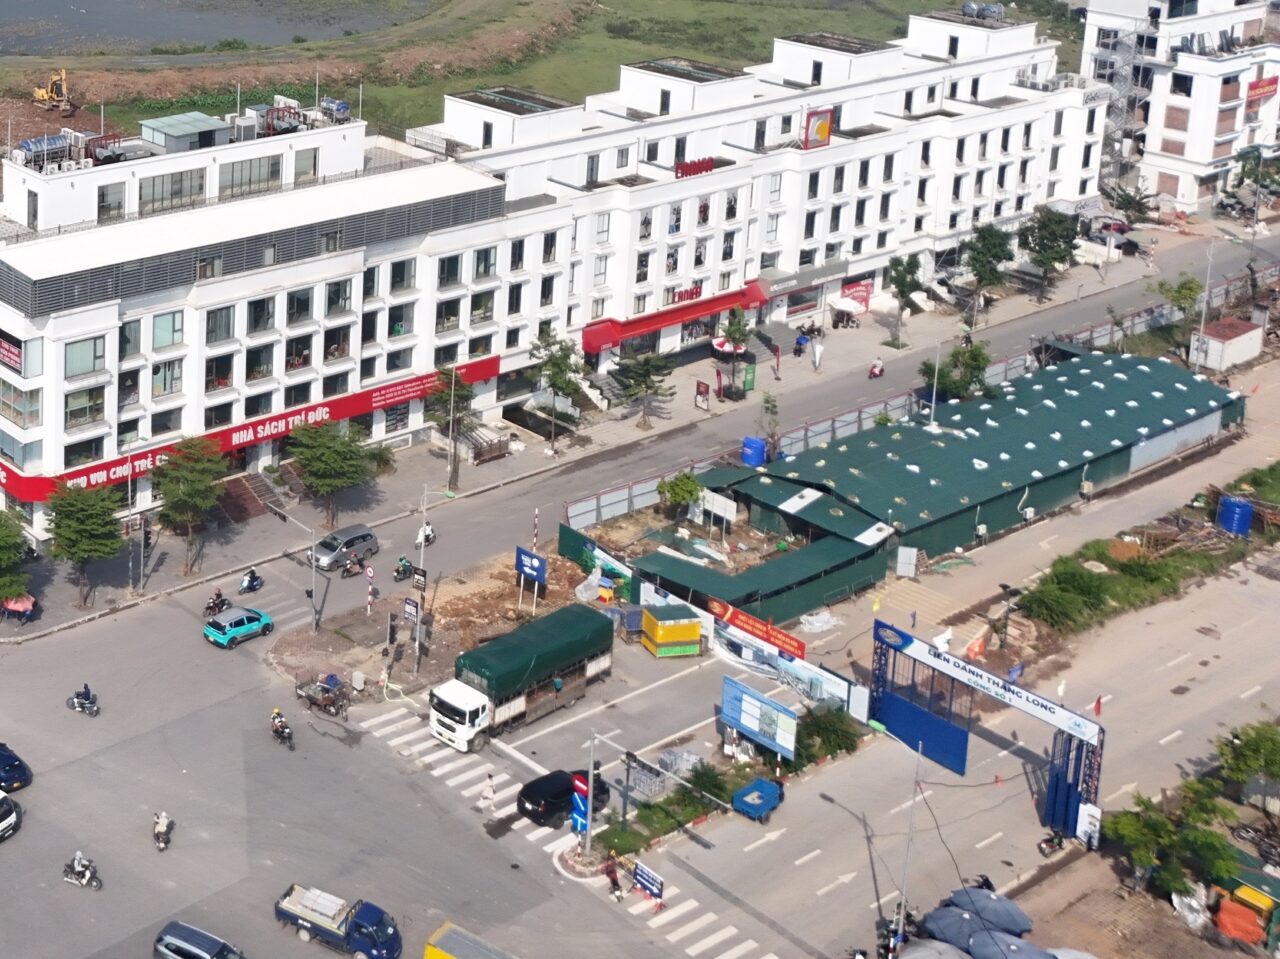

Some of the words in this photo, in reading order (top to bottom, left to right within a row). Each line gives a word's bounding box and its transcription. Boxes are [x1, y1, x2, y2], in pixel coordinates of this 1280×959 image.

[232, 425, 255, 446] NHÀ
[257, 420, 286, 439] SÁCH
[89, 469, 108, 486] VUI
[952, 660, 984, 680] DANH
[1025, 695, 1057, 715] LONG
